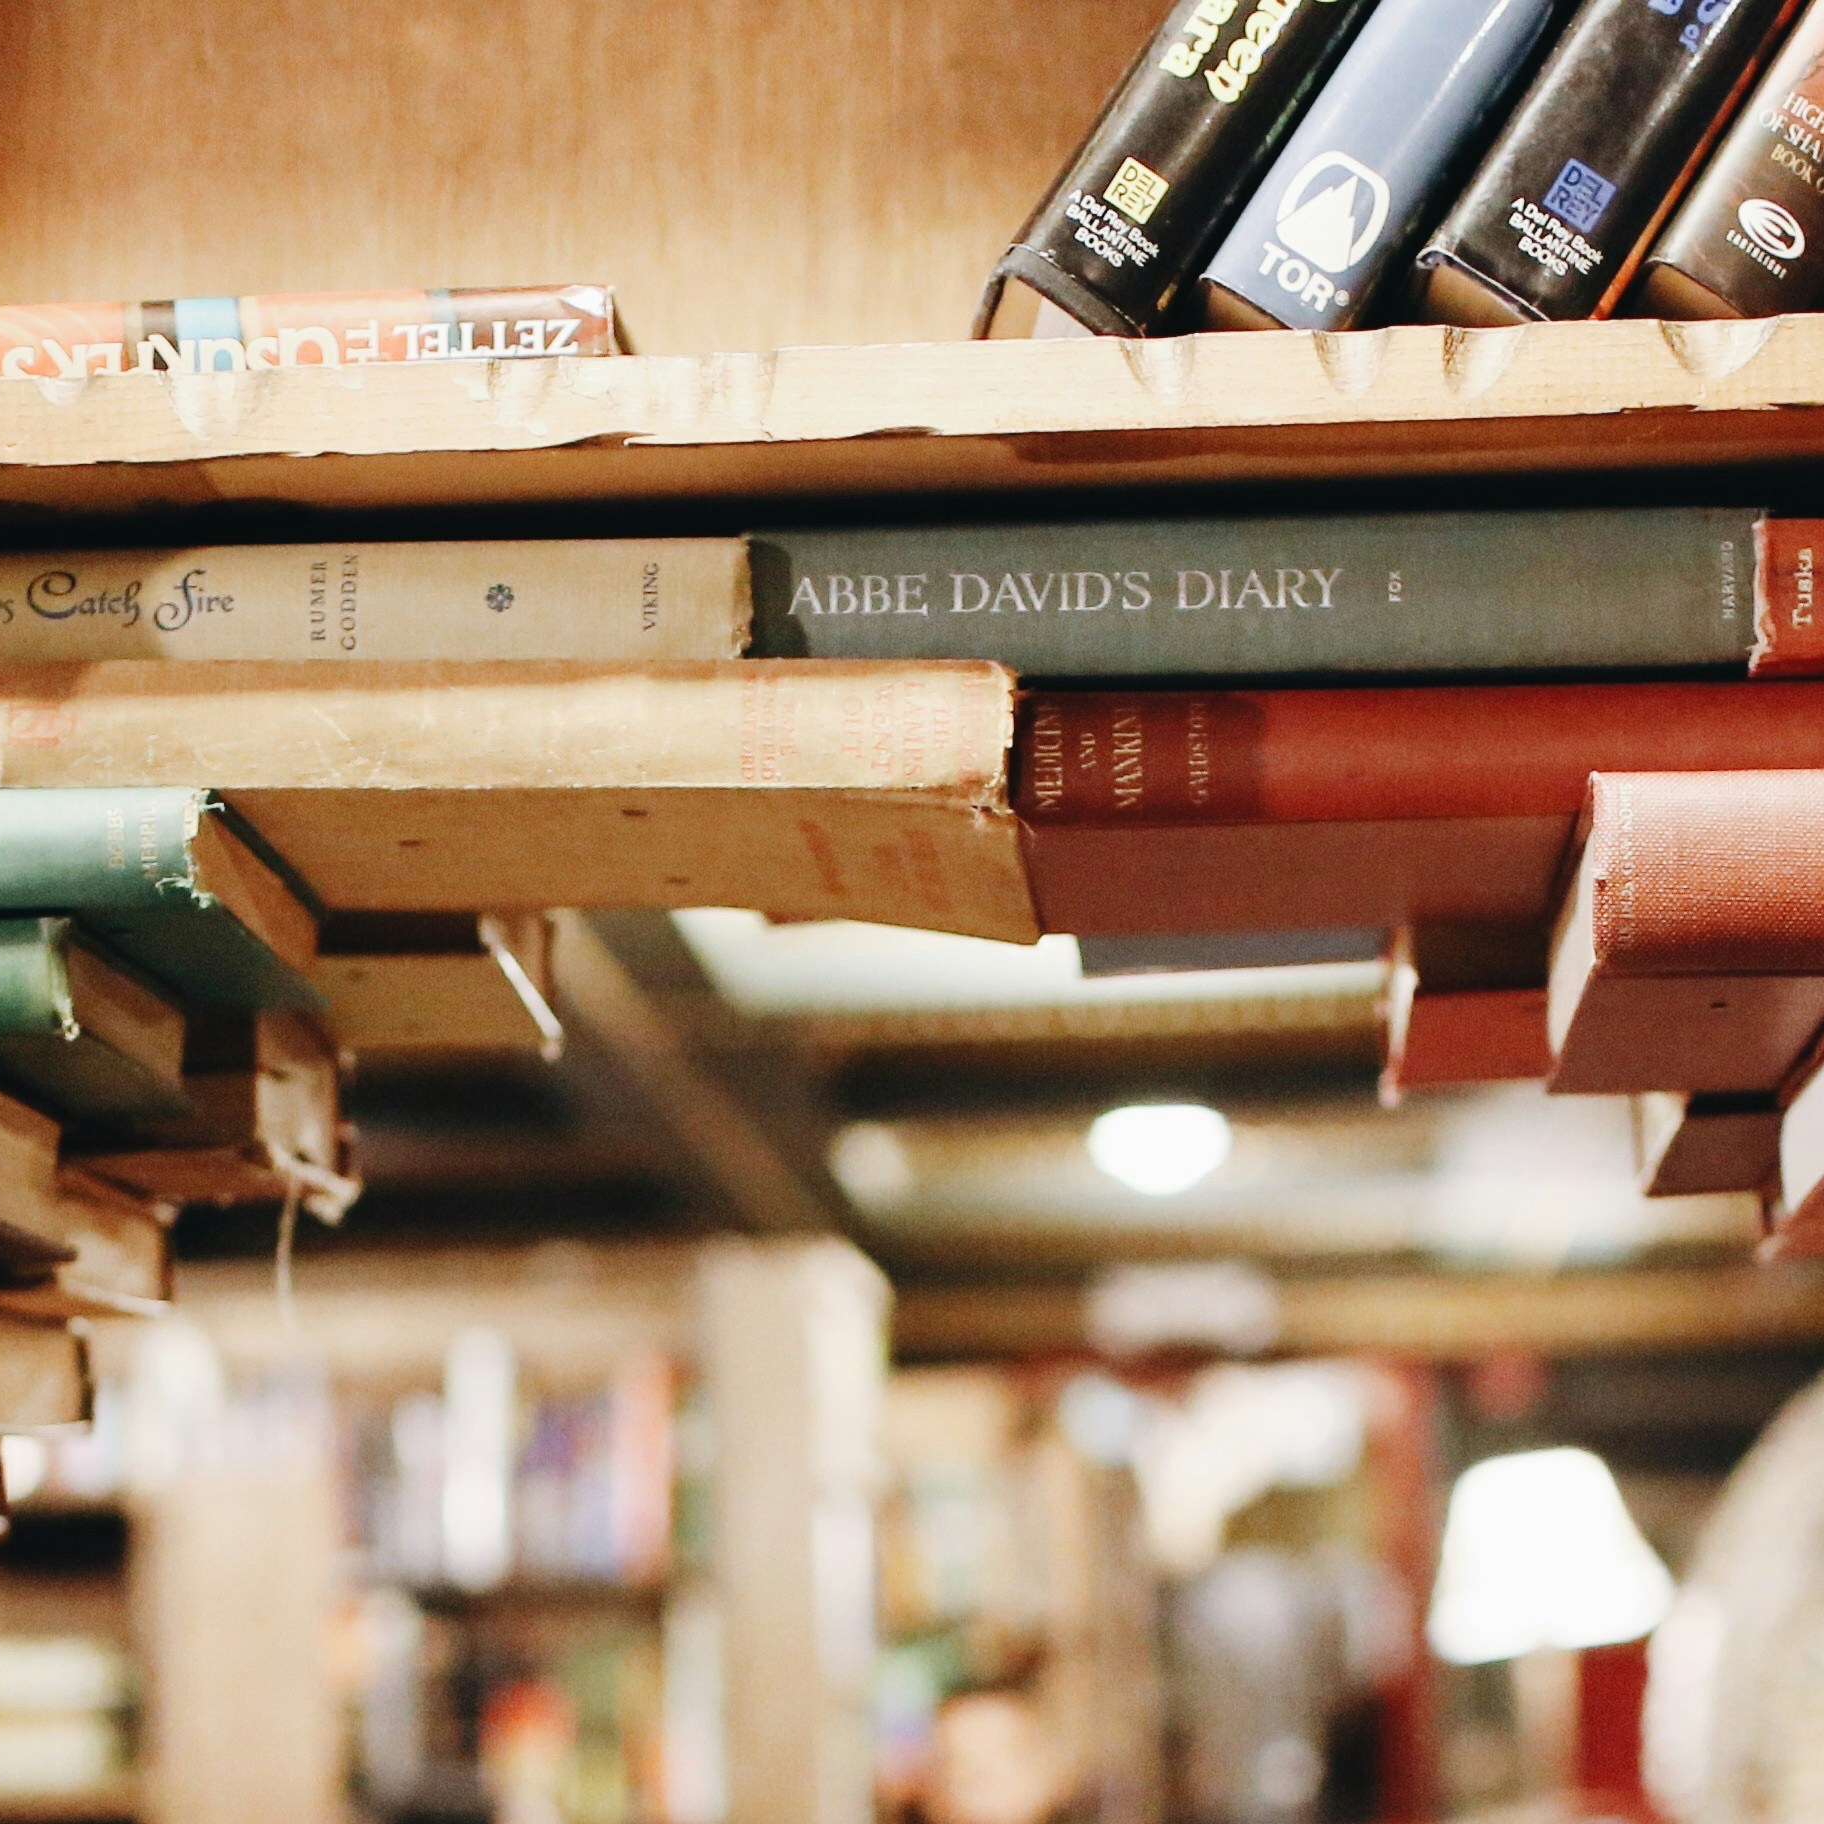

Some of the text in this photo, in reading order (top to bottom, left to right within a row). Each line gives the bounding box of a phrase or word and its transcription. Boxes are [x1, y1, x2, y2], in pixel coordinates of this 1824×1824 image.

[1064, 203, 1148, 269] BALLANTINE
[1074, 227, 1125, 269] BOOKS
[1508, 212, 1593, 277] BALLANTINE
[1518, 237, 1568, 278] BOOKS
[1256, 239, 1334, 313] TOR
[393, 319, 581, 358] ZETTEL
[25, 570, 143, 628] Catch
[307, 561, 328, 642] RUMER
[339, 553, 359, 651] GODDEN
[641, 563, 660, 635] VIKING
[787, 568, 1342, 620] ABBE DAVID'S DIARY
[1388, 570, 1403, 604] FOX
[1789, 546, 1816, 630] Tuska
